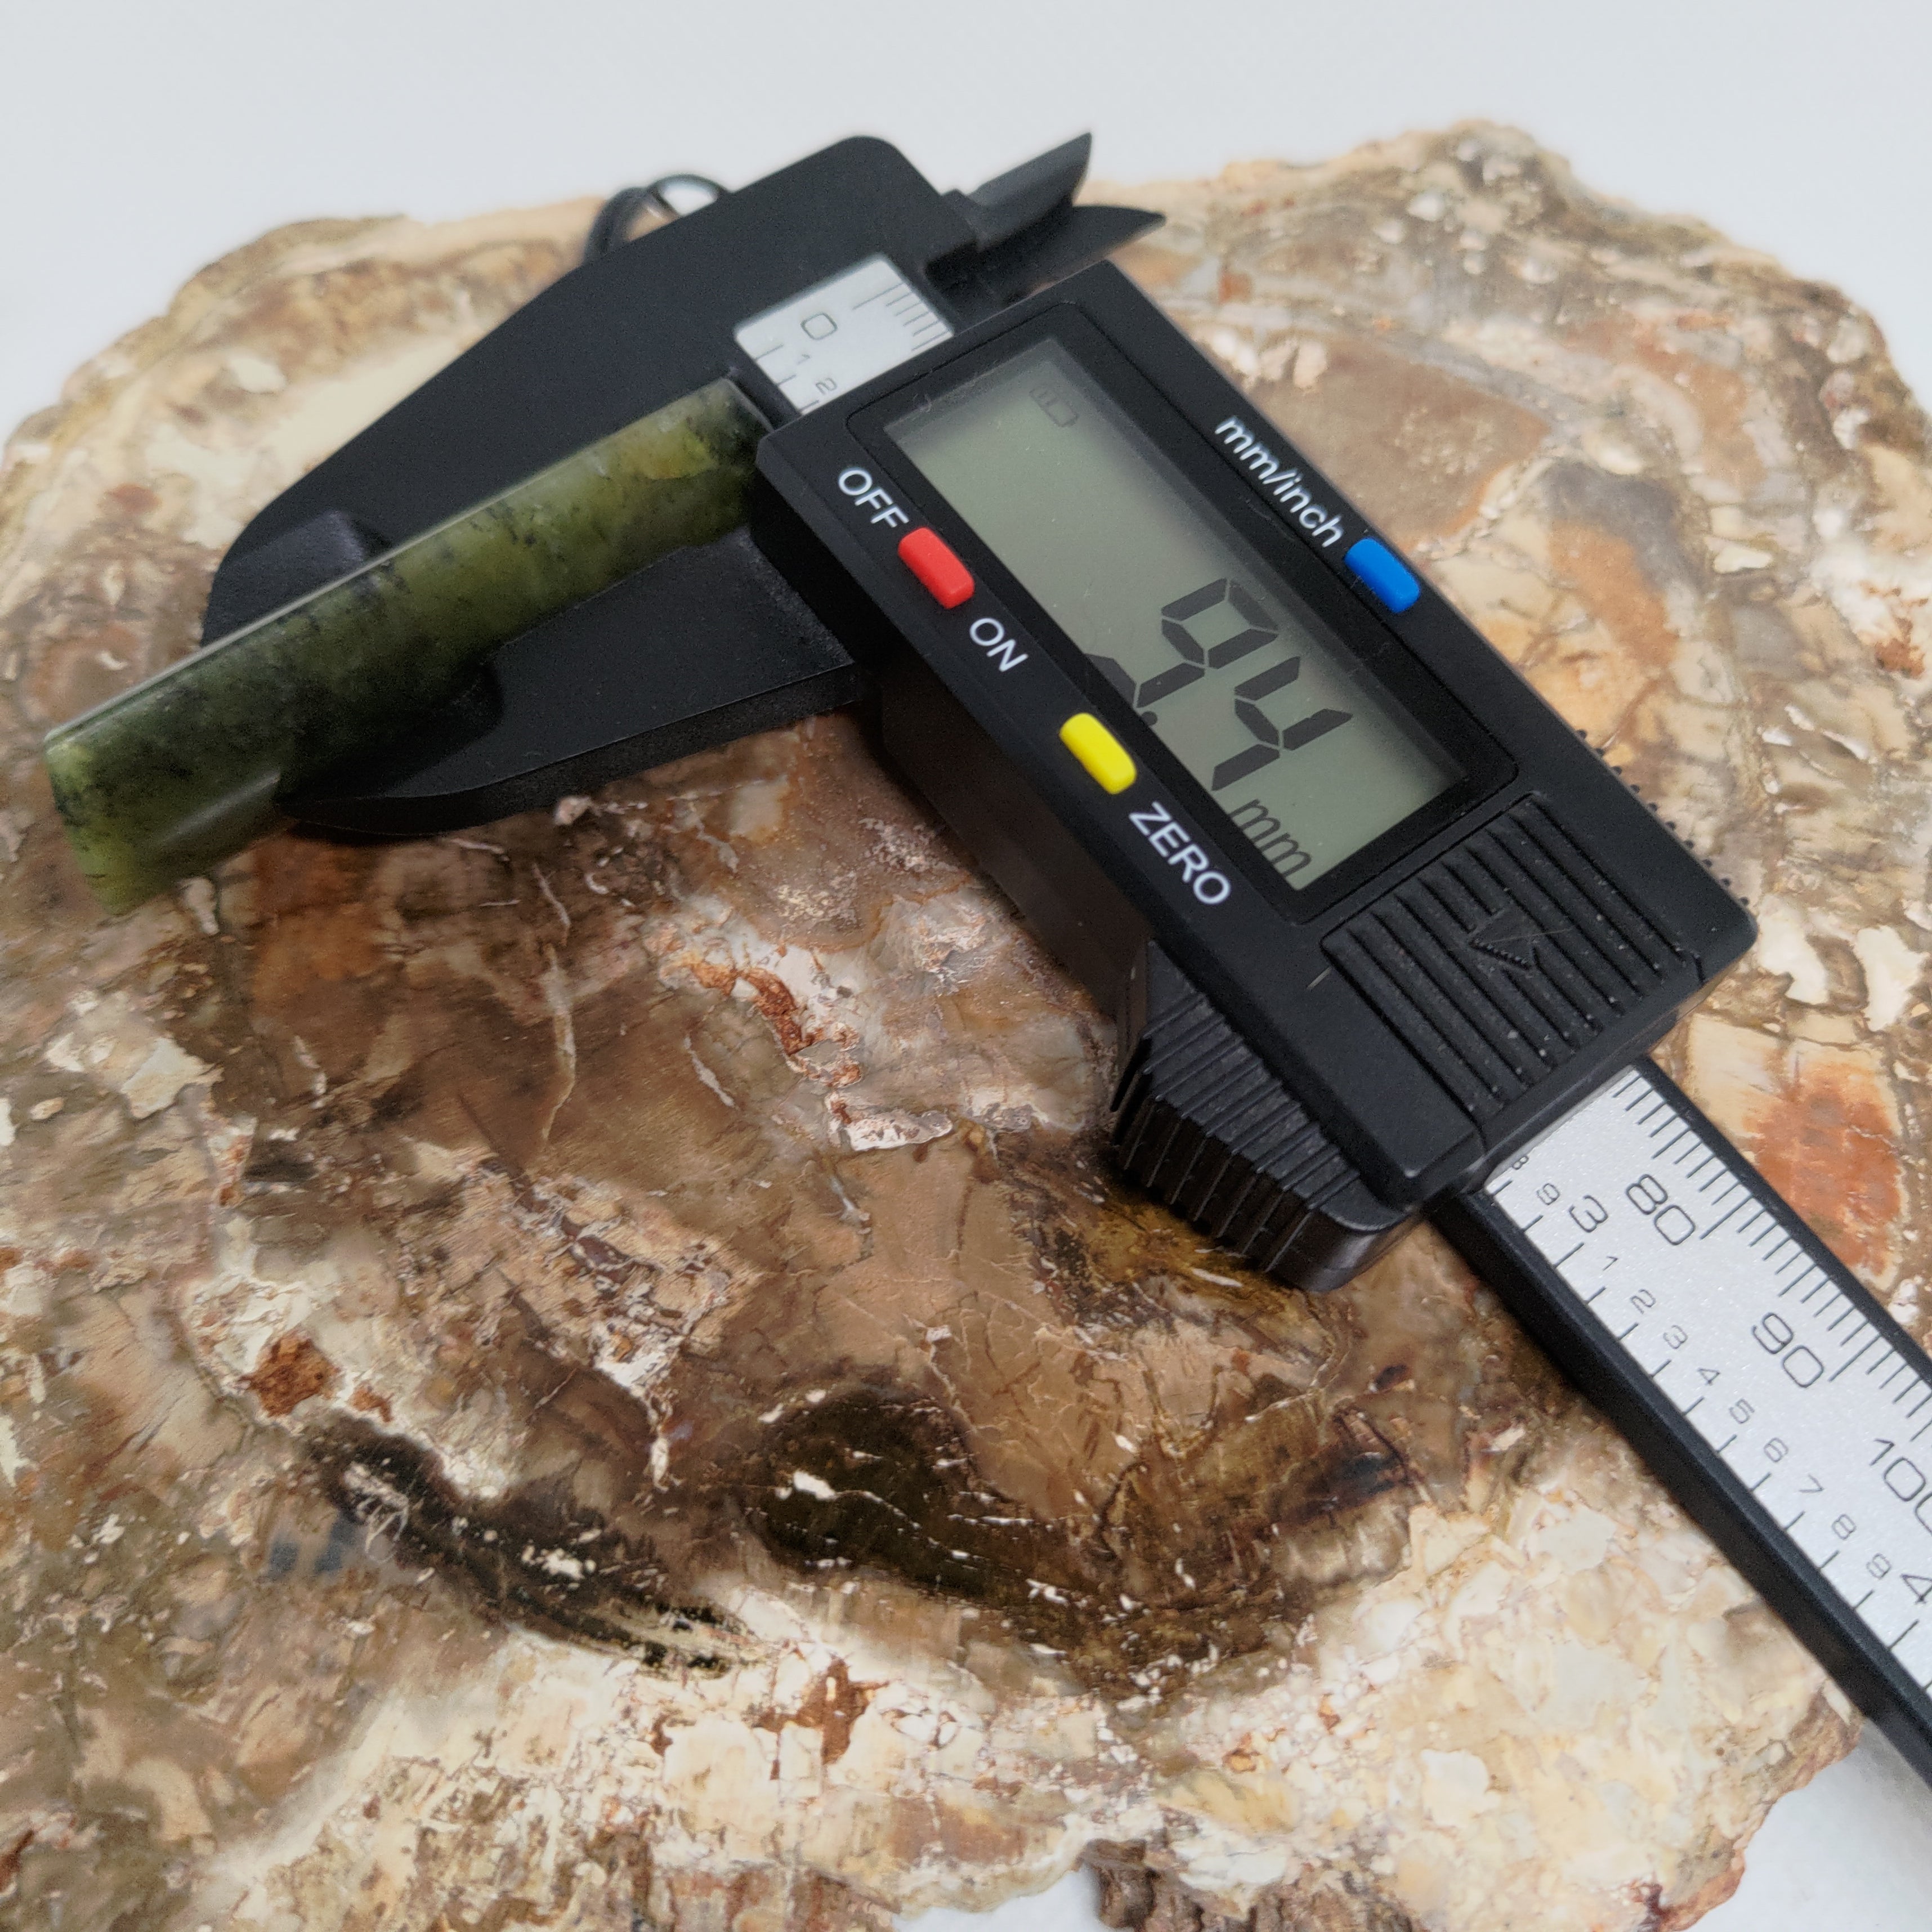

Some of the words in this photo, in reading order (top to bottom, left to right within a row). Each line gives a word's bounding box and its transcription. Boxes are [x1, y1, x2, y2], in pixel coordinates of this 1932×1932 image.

[800, 312, 838, 341] 0
[797, 354, 811, 366] 1
[815, 377, 838, 395] 2
[838, 468, 910, 528] OFF
[1214, 415, 1344, 548] mm/inch
[969, 617, 1030, 673] ON
[1128, 801, 1232, 905] ZERO
[1228, 798, 1312, 877] mm
[1625, 1173, 1697, 1246] 80
[1751, 1311, 1826, 1389] 90
[1536, 1183, 1561, 1206] 9
[1568, 1194, 1609, 1234] 3
[1602, 1255, 1619, 1272] 1
[1629, 1289, 1657, 1314] 2
[1662, 1325, 1688, 1350] 3
[1697, 1368, 1721, 1386] 4
[1728, 1398, 1755, 1424] 5
[1763, 1437, 1789, 1463] 6
[1799, 1474, 1824, 1493] 7
[1831, 1514, 1857, 1540] 8
[1866, 1553, 1892, 1580] 9
[1899, 1573, 1932, 1605] 4
